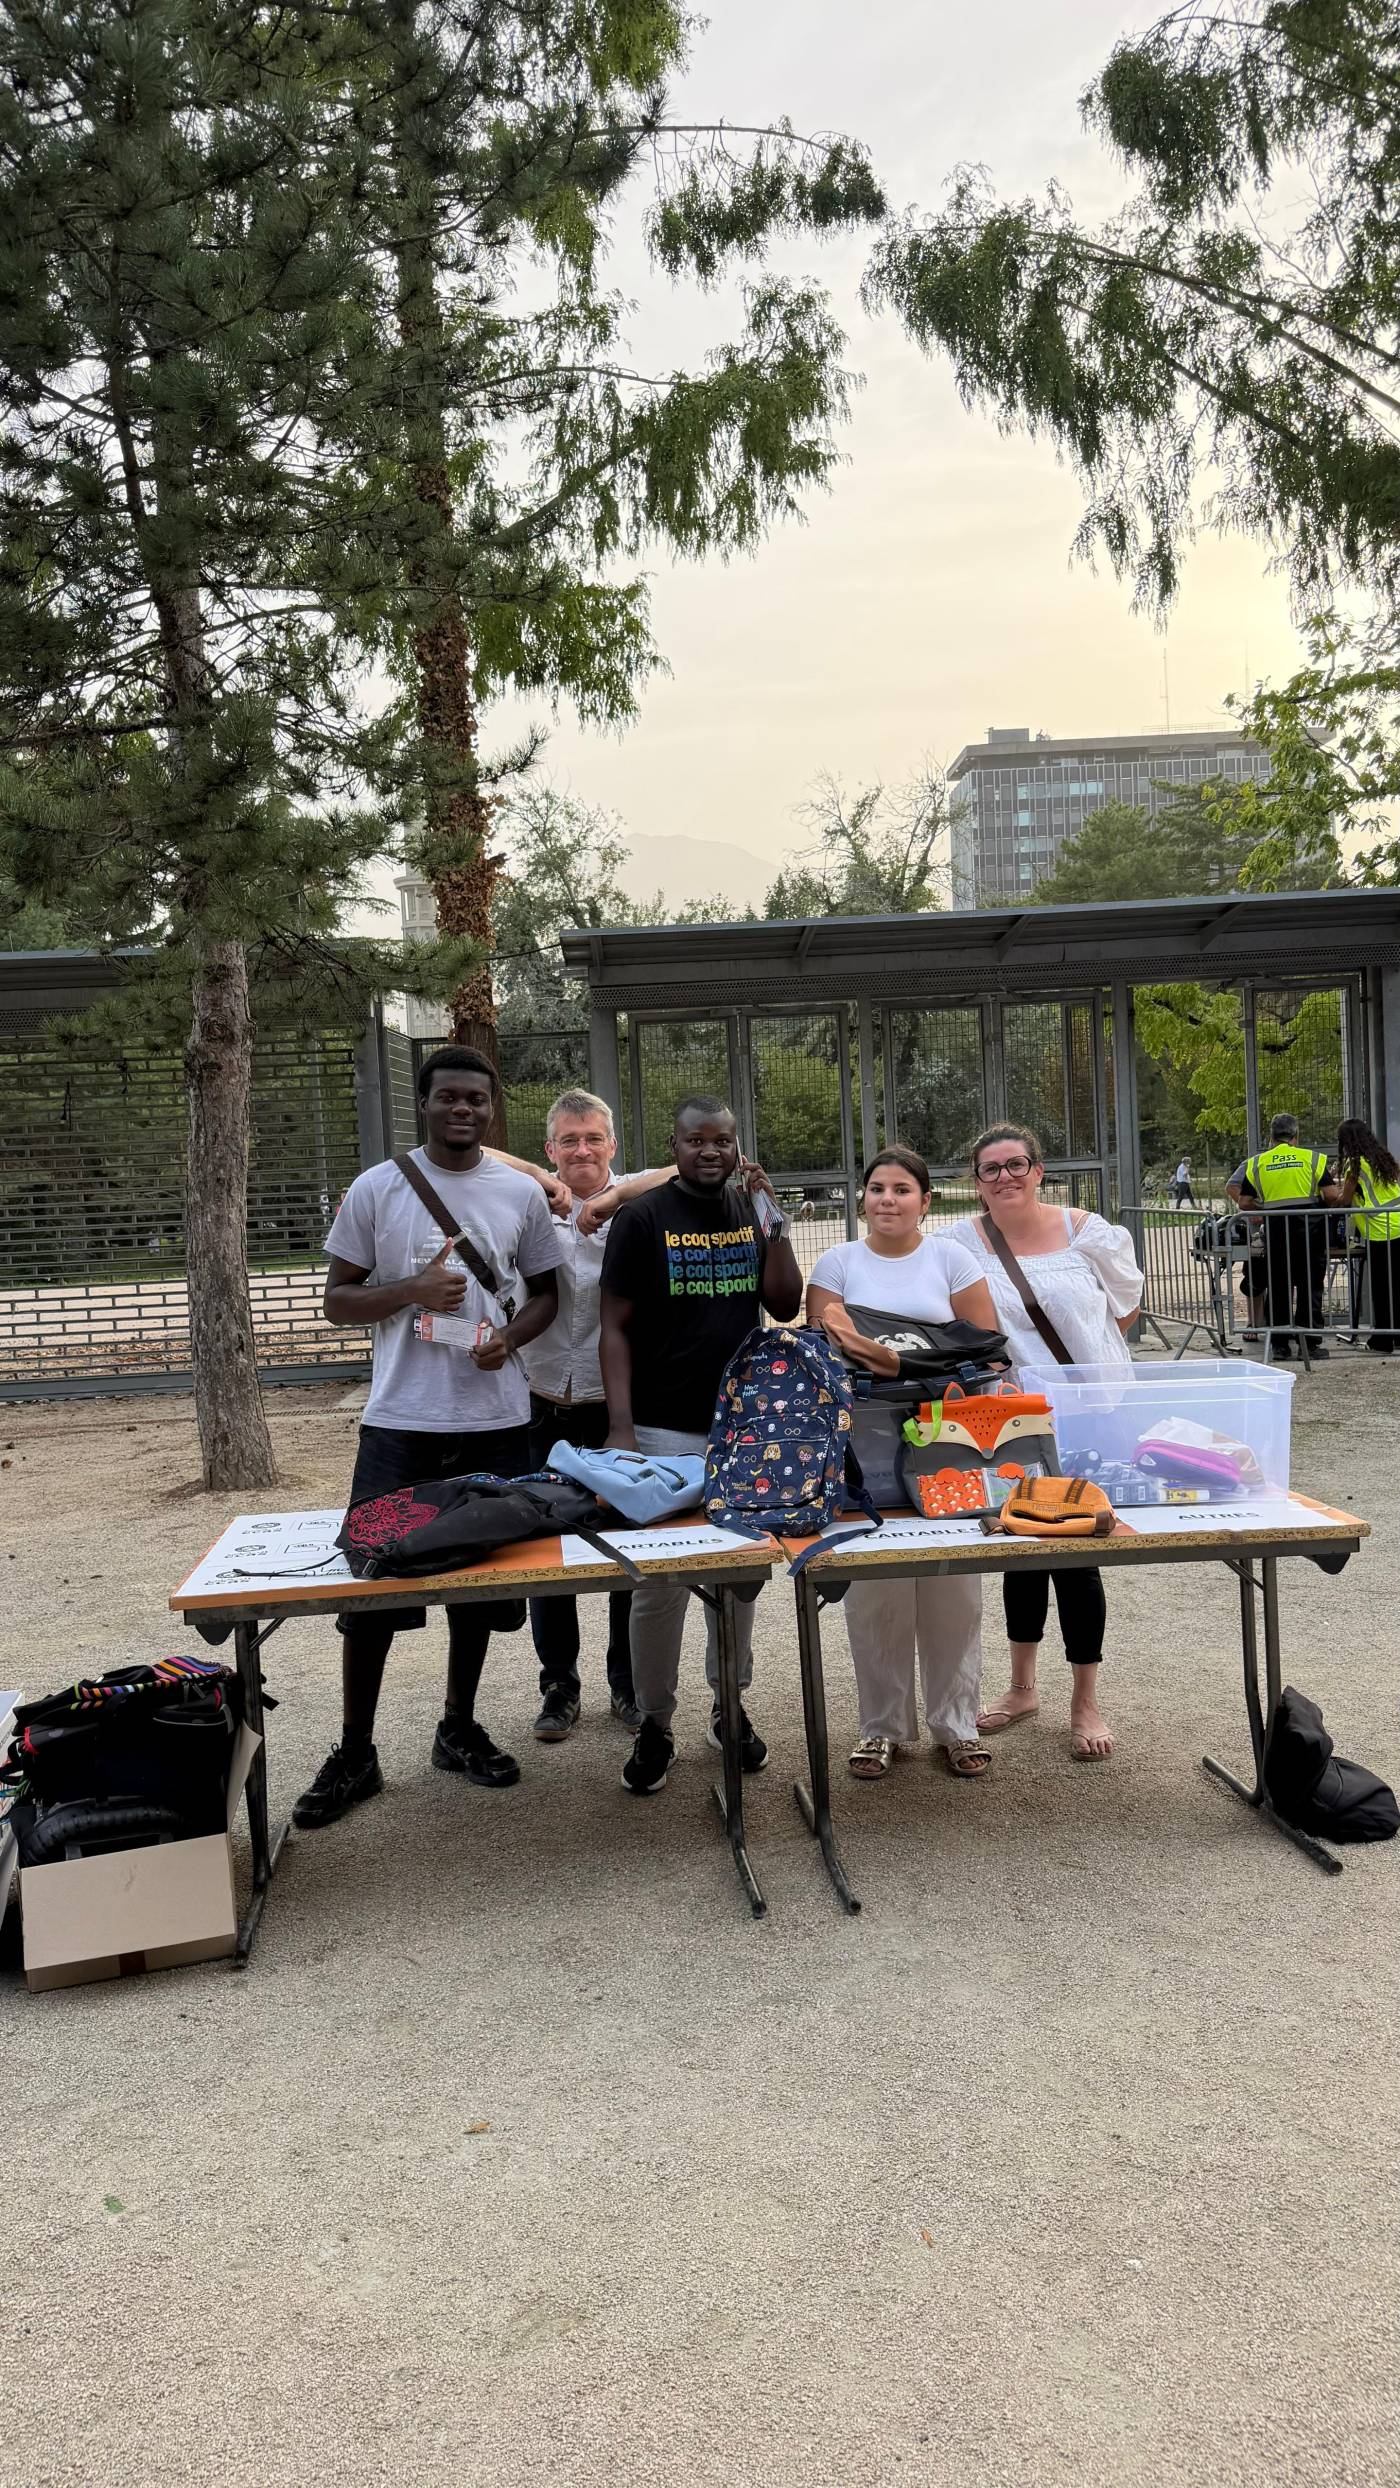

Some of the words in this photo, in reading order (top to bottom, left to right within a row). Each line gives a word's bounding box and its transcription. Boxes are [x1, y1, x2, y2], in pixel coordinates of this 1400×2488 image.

[1272, 1154, 1297, 1163] Pass
[664, 1230, 680, 1247] le
[681, 1232, 711, 1249] coq
[711, 1225, 755, 1248] sportif
[667, 1247, 683, 1263] le
[684, 1248, 712, 1264] coq
[713, 1241, 758, 1263] sportif
[668, 1262, 684, 1279] le
[685, 1264, 713, 1281] coq
[669, 1278, 685, 1296] le
[686, 1280, 714, 1298] coq
[715, 1274, 758, 1297] sporti
[1178, 1512, 1261, 1520] AUTRES
[864, 1527, 981, 1539] CARTABLES
[616, 1538, 723, 1550] ARTABLES
